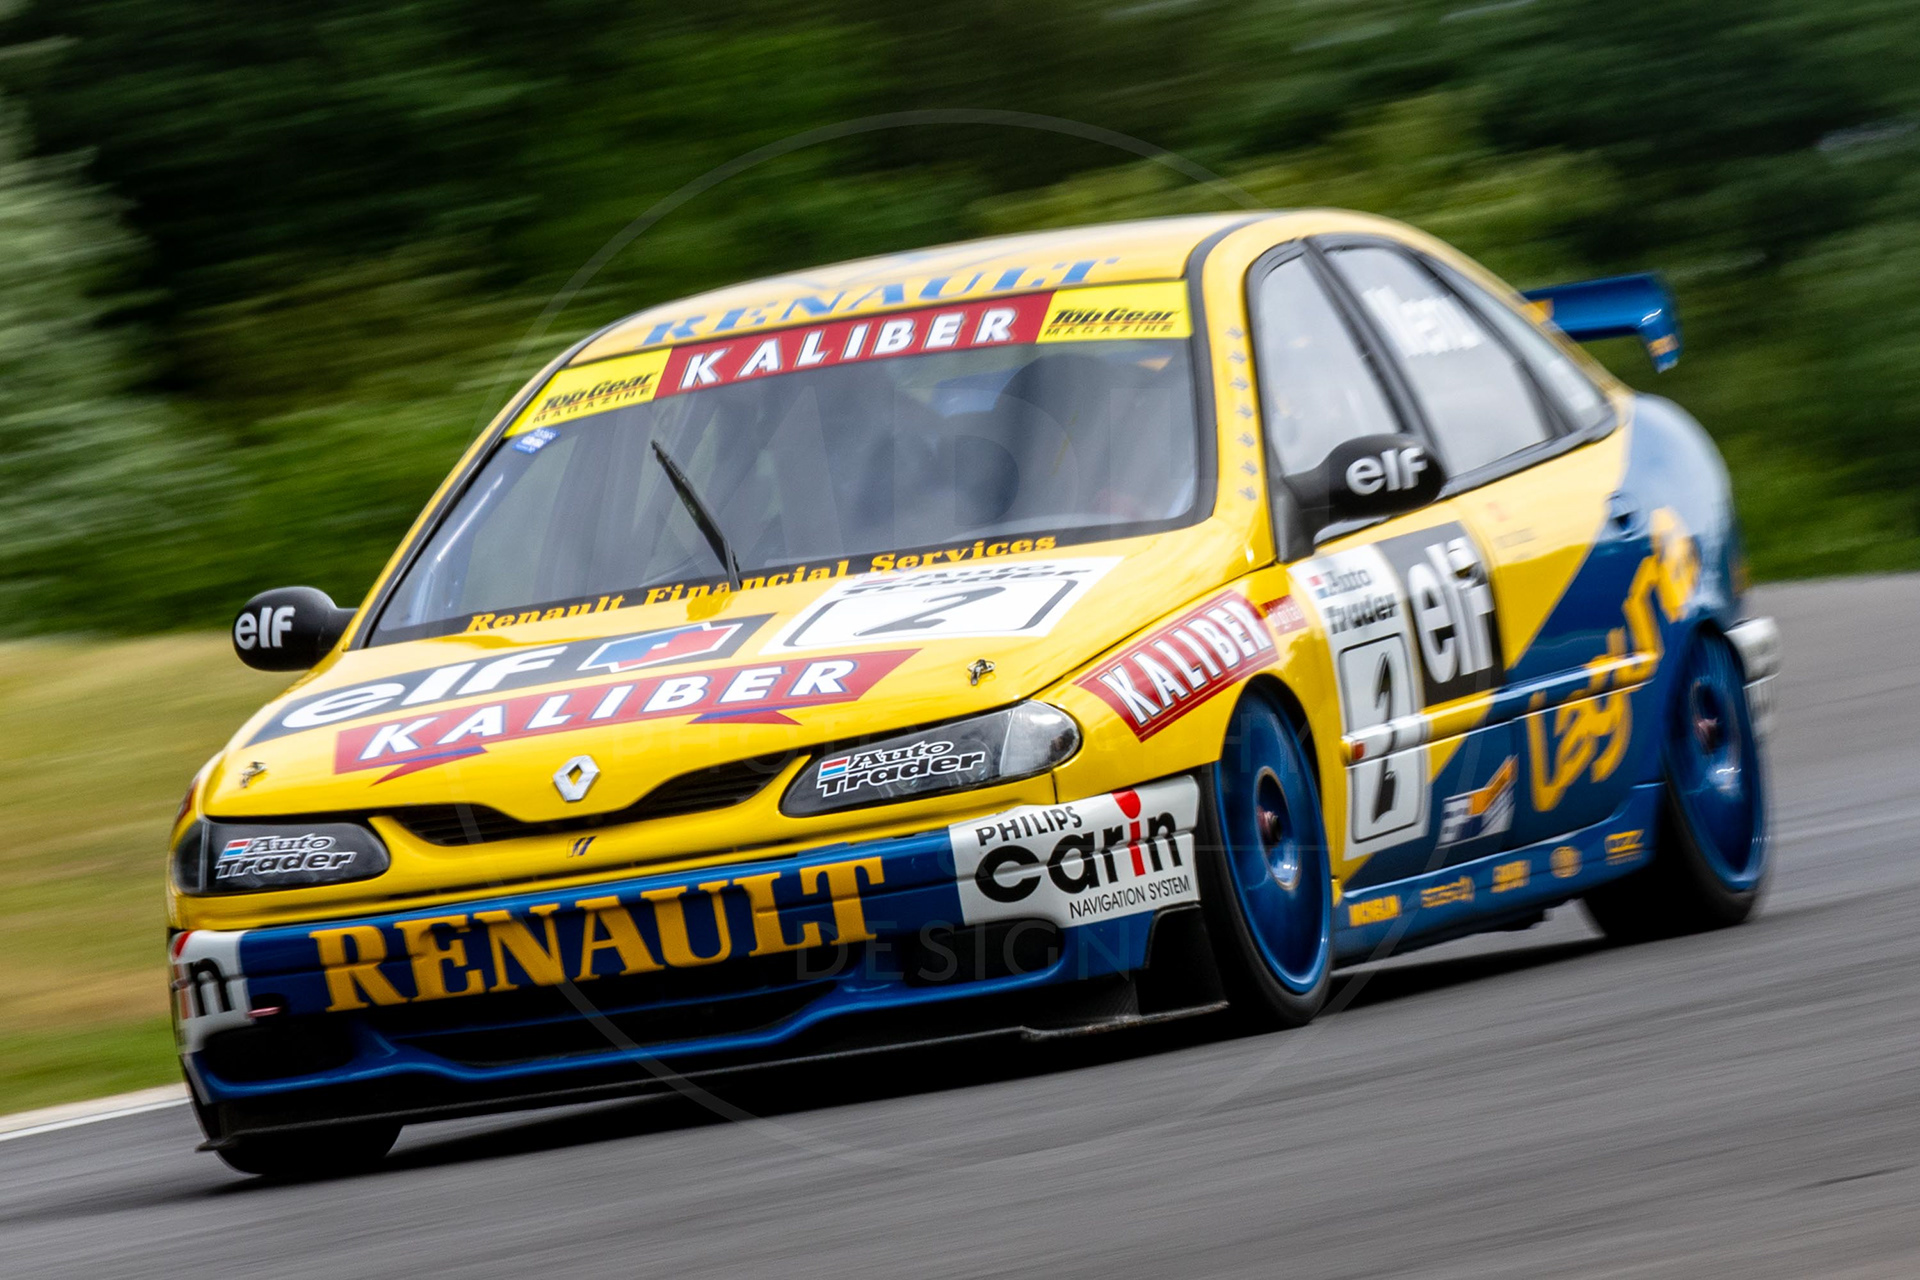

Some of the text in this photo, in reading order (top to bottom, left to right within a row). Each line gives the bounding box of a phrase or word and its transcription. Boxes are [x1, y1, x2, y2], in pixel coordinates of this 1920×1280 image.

[638, 258, 1119, 347] RENAULT
[677, 307, 1018, 390] KALIBER
[1045, 324, 1174, 336] MAGAZINE
[532, 387, 651, 424] MAGAZINE
[1346, 446, 1428, 496] elf
[466, 535, 1058, 633] Renault Financial Services
[234, 606, 295, 650] elf
[853, 586, 1007, 637] 2
[1408, 536, 1496, 684] elf
[282, 646, 567, 729] elf
[1099, 599, 1274, 726] KALIBER
[359, 660, 858, 761] KALIBER
[816, 751, 985, 798] Trader
[847, 741, 954, 771] Auto
[247, 834, 337, 859] Auto
[975, 788, 1183, 903] carin
[976, 806, 1083, 846] PHILIPS
[216, 848, 356, 880] Trader
[1069, 875, 1191, 919] NAVIGATION SYSTEM
[309, 856, 886, 1013] RENAULT
